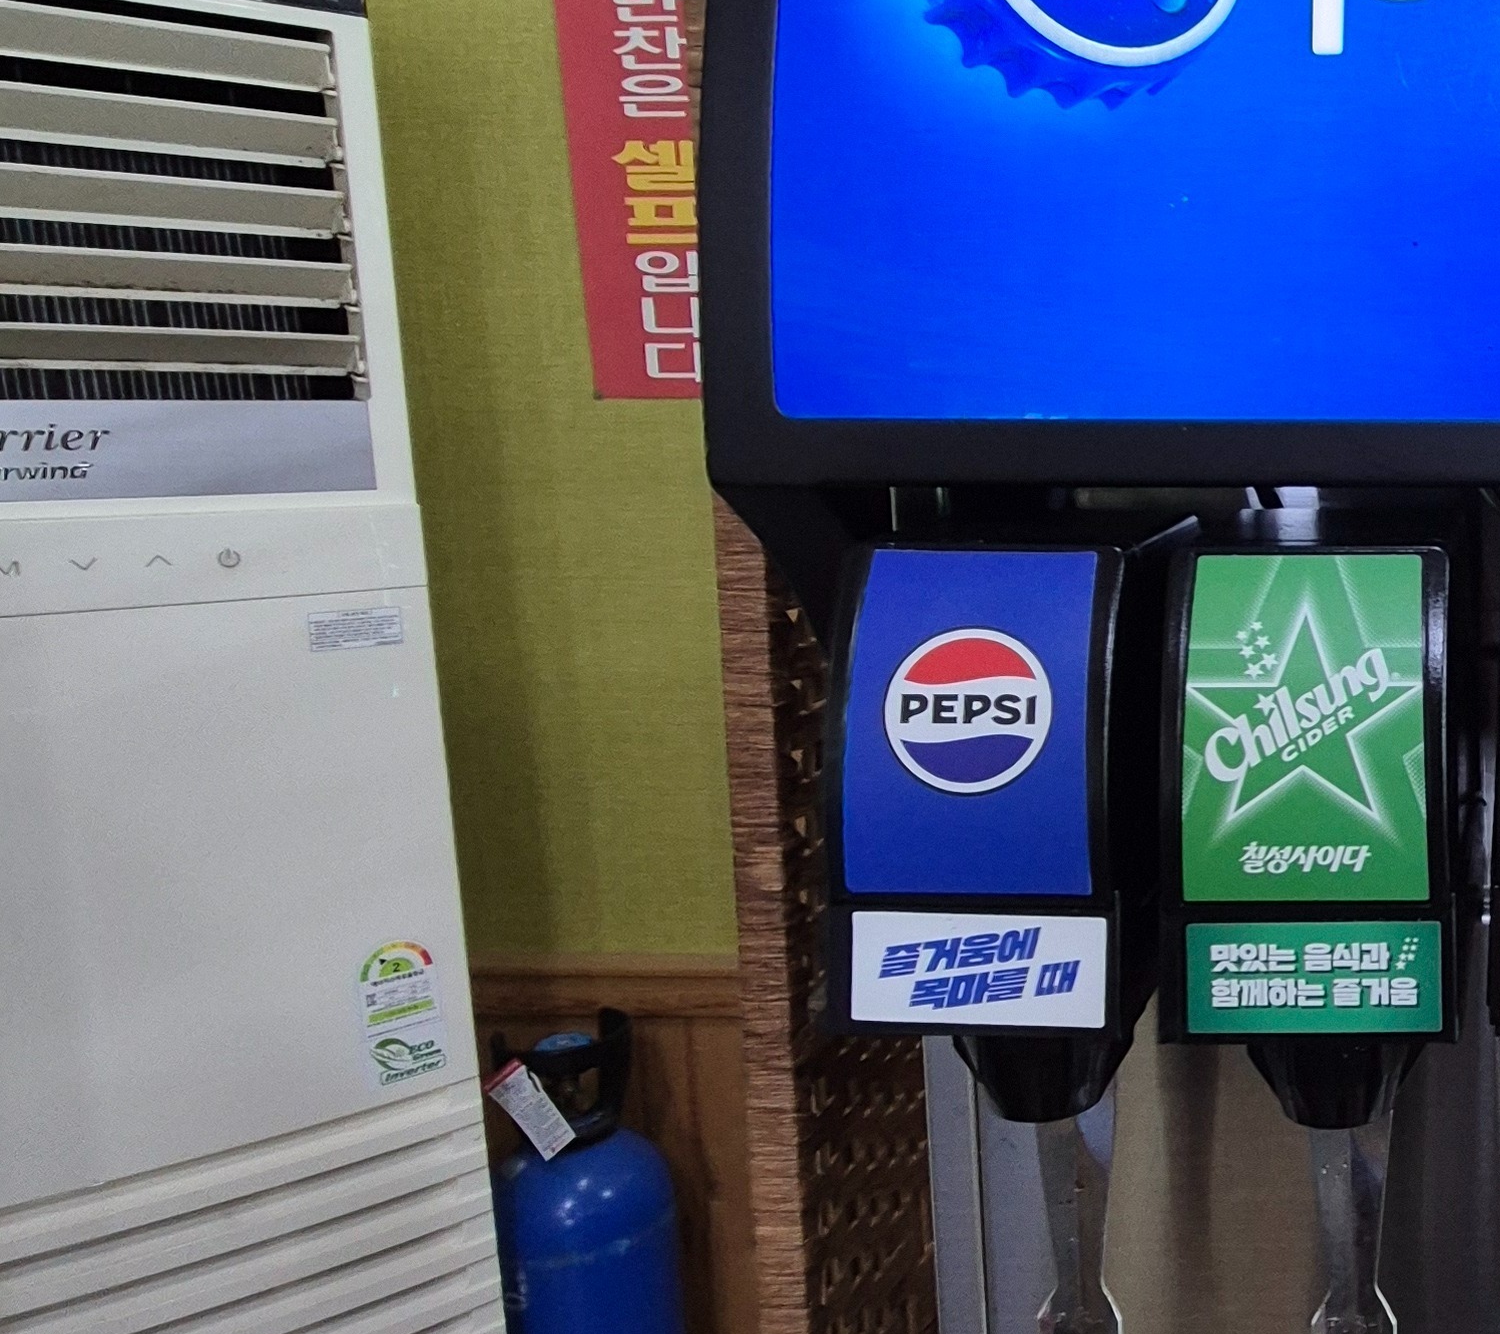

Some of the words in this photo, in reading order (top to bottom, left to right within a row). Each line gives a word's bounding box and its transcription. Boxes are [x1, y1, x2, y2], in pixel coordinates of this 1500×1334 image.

[900, 693, 1037, 725] PEPSI
[1204, 648, 1393, 783] Chilsung
[1280, 705, 1356, 764] CIDER
[1238, 841, 1371, 874] 칠성사이다
[878, 926, 1042, 979] 즐거움에
[1210, 944, 1296, 973] 맛있는
[1303, 942, 1390, 972] 음식과
[908, 967, 1031, 1010] 목마를
[1034, 960, 1081, 997] 때
[1211, 978, 1325, 1009] 함께하는
[1333, 977, 1419, 1008] 즐거움
